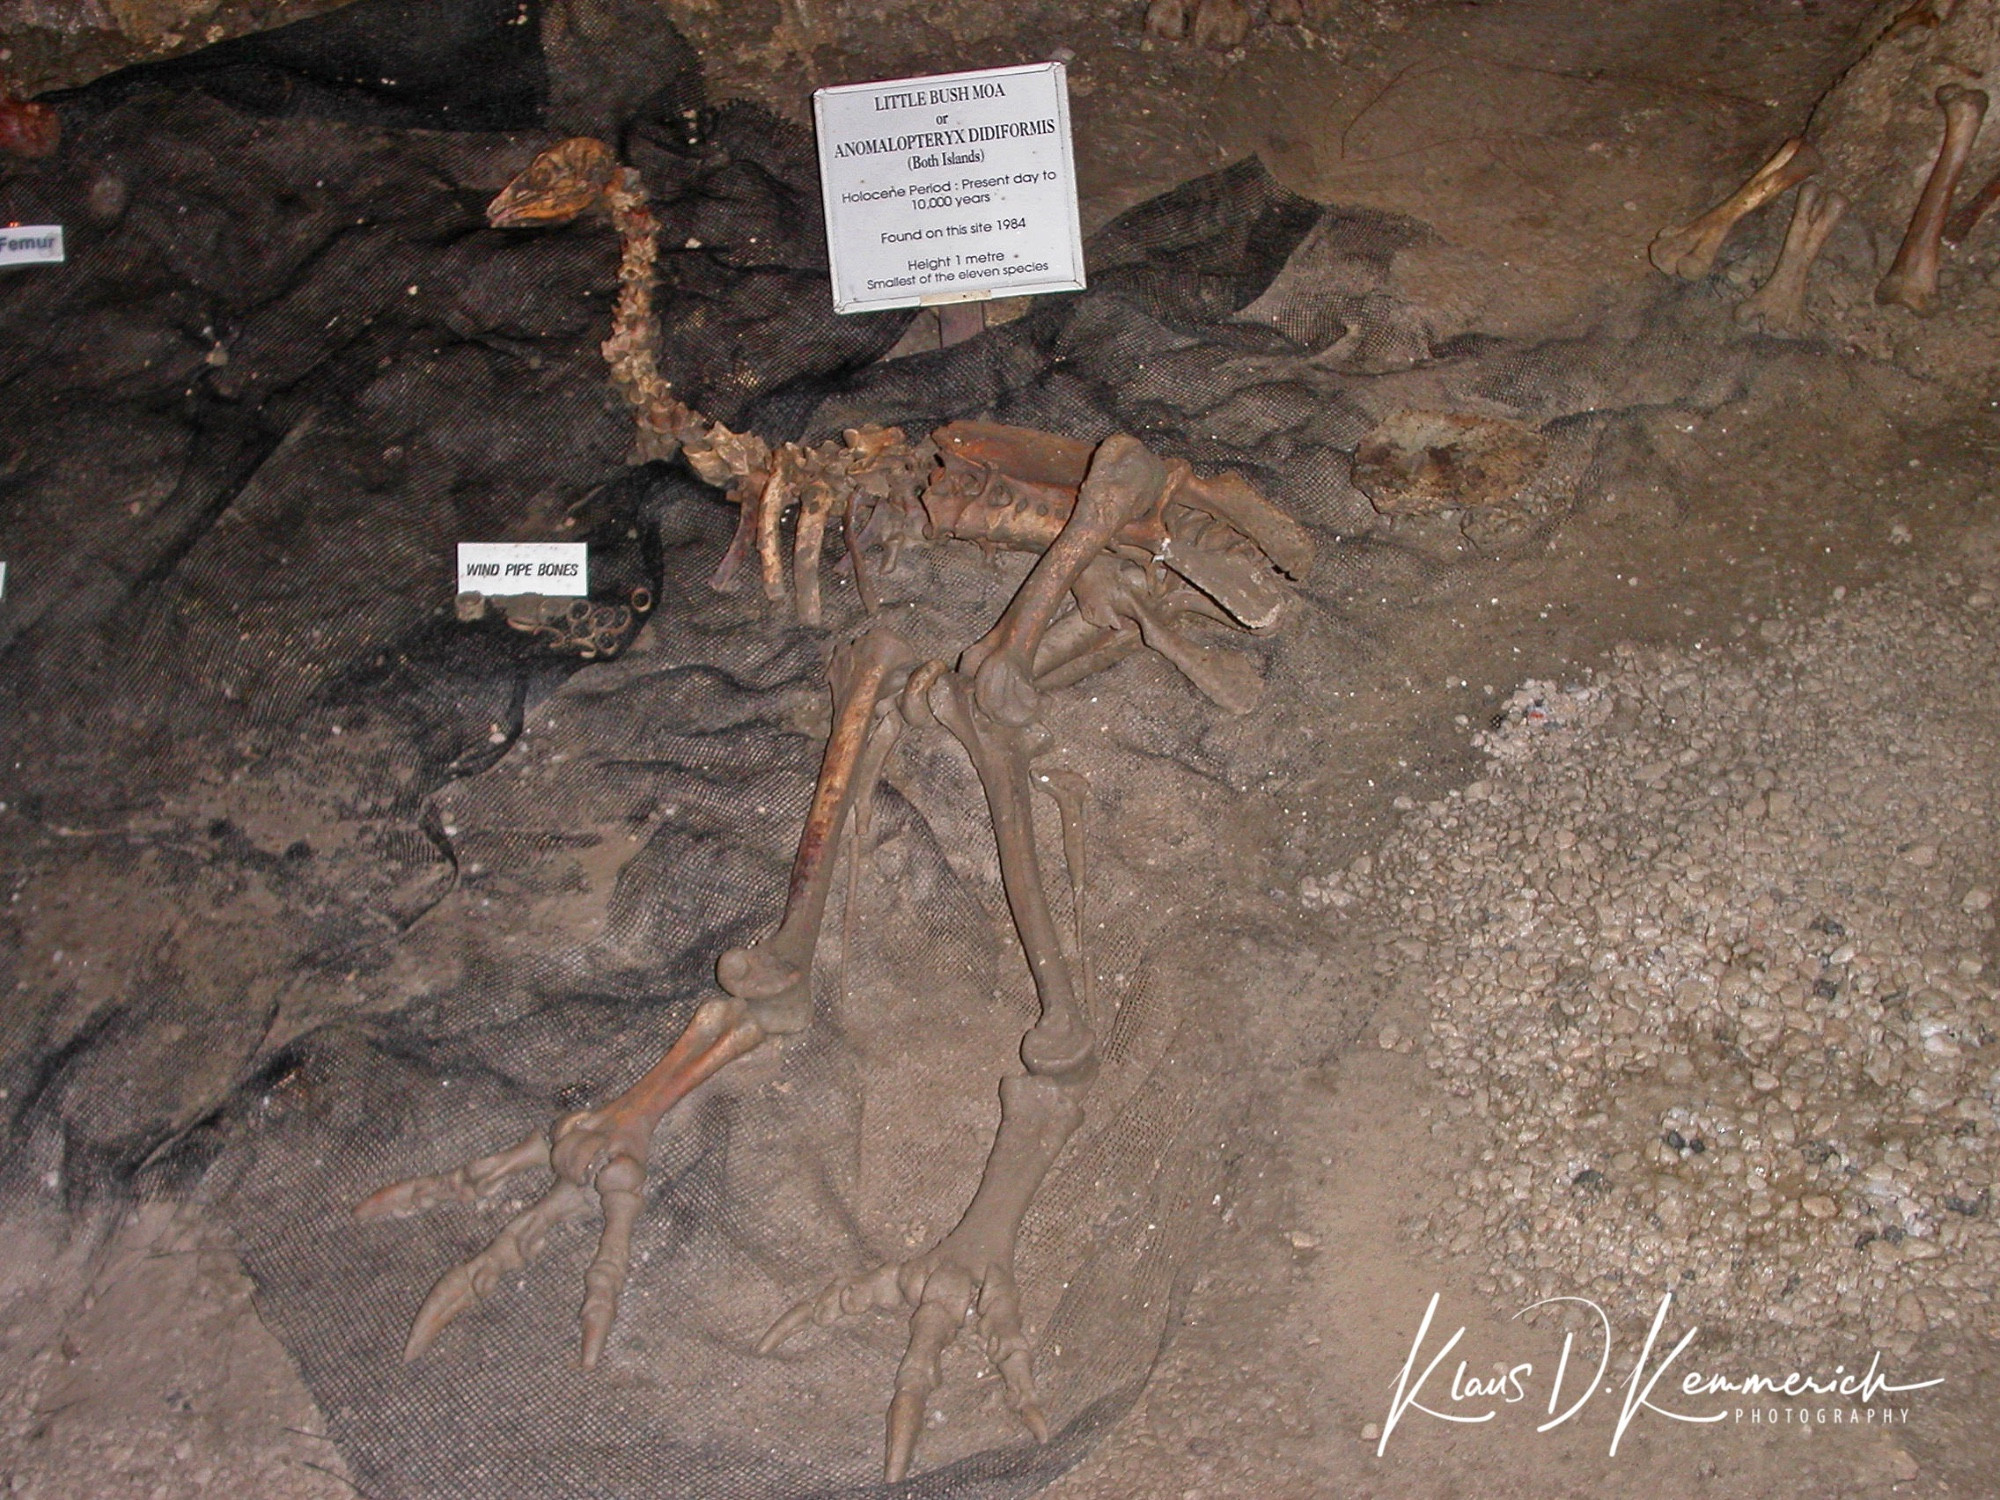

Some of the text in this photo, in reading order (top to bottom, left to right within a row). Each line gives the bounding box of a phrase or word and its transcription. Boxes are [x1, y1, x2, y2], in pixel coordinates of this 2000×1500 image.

[874, 83, 1006, 111] LITTLE BUSH MOA
[936, 114, 948, 126] or
[834, 118, 1055, 158] ANOMALOPTERYX DIDIFORMIS
[908, 148, 985, 170] (Both Islands)
[842, 186, 905, 203] Holocene
[910, 181, 951, 196] Period
[962, 174, 1010, 189] Present
[1013, 172, 1039, 186] day
[1042, 169, 1056, 180] to
[912, 192, 991, 210] 10,000 years
[881, 217, 1026, 244] Found on this site 1984
[908, 251, 1005, 272] Height 1 metre
[867, 261, 1049, 290] Smallest of the eleven species
[466, 563, 579, 576] WIND PIPE BONES
